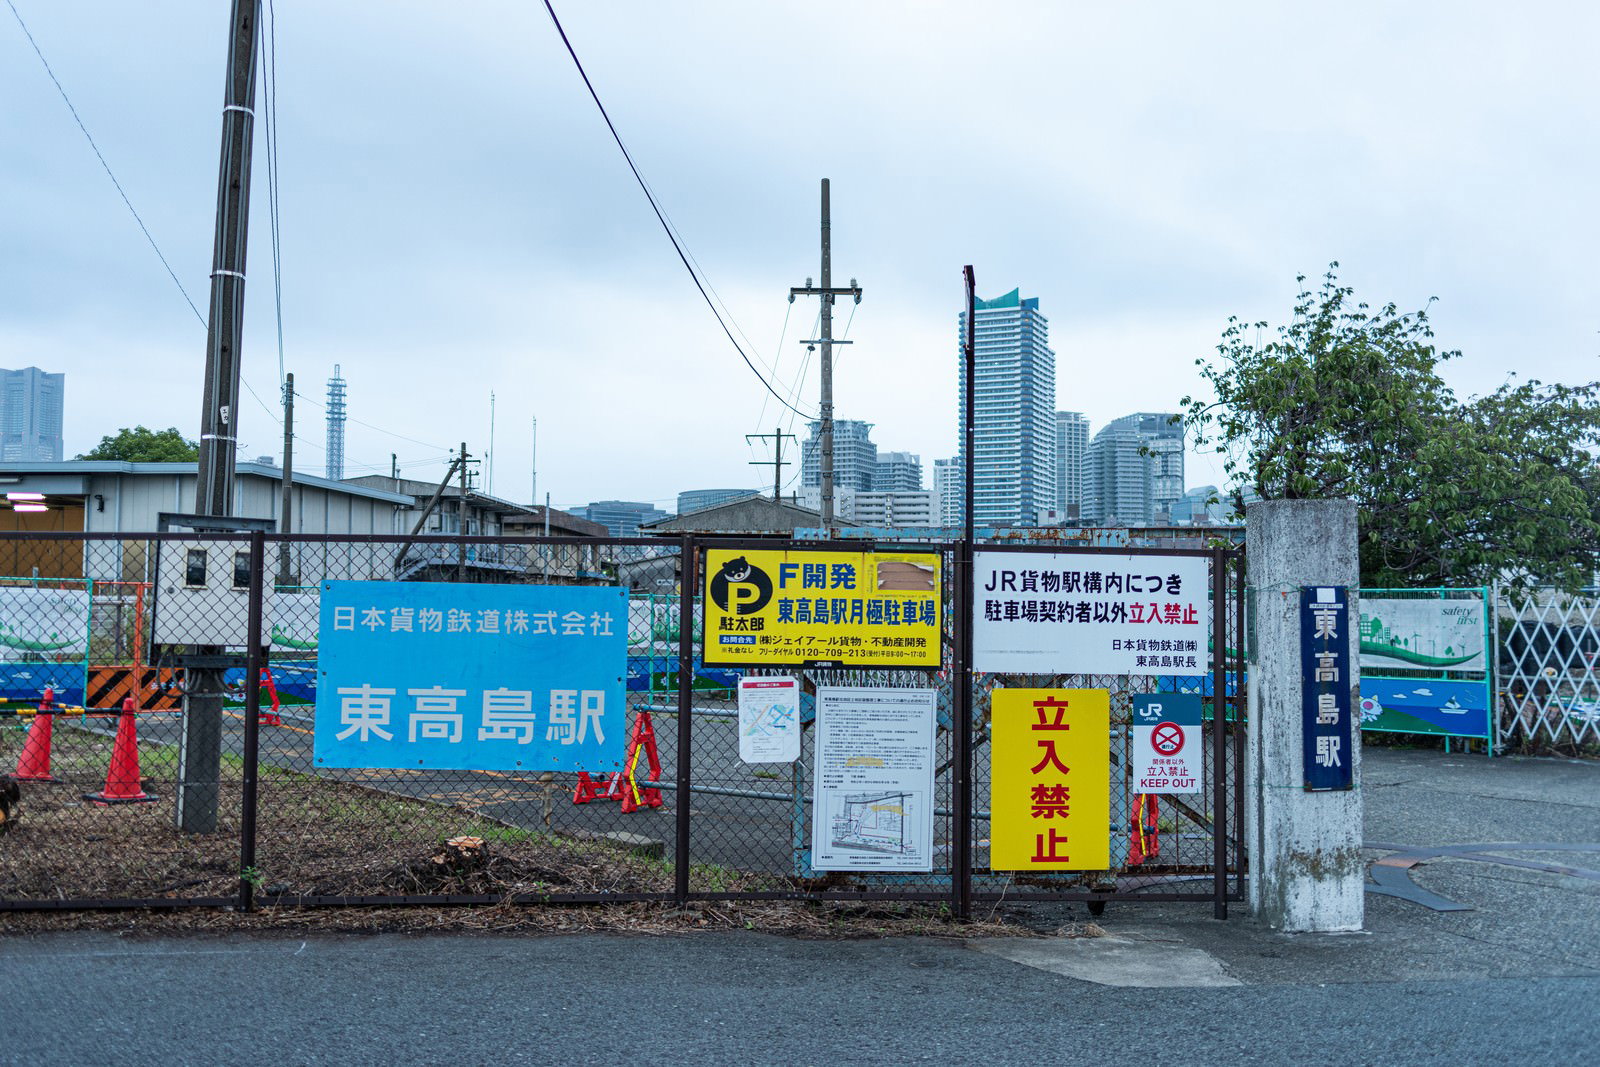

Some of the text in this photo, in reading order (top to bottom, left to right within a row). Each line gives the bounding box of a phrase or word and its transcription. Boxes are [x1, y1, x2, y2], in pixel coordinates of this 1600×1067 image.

[779, 563, 857, 589] F開発
[984, 570, 1182, 595] JR貨物駅構内につき
[333, 606, 614, 636] 日本貨物鉄道株式会社
[719, 616, 764, 631] 駐太郎
[776, 597, 936, 626] 東高島駅月極駐車場
[984, 600, 1199, 625] 駐車場契約者以外立入禁止
[1441, 606, 1473, 618] safety
[1456, 615, 1478, 625] first
[1136, 655, 1197, 668] 東高島駅長
[1313, 608, 1341, 767] 東高島駅
[335, 683, 605, 745] 東高島駅
[1139, 703, 1162, 717] JR
[1030, 696, 1070, 862] 立入禁止
[1140, 779, 1196, 788] KEEP OUT
[1147, 766, 1188, 776] 立入禁止
